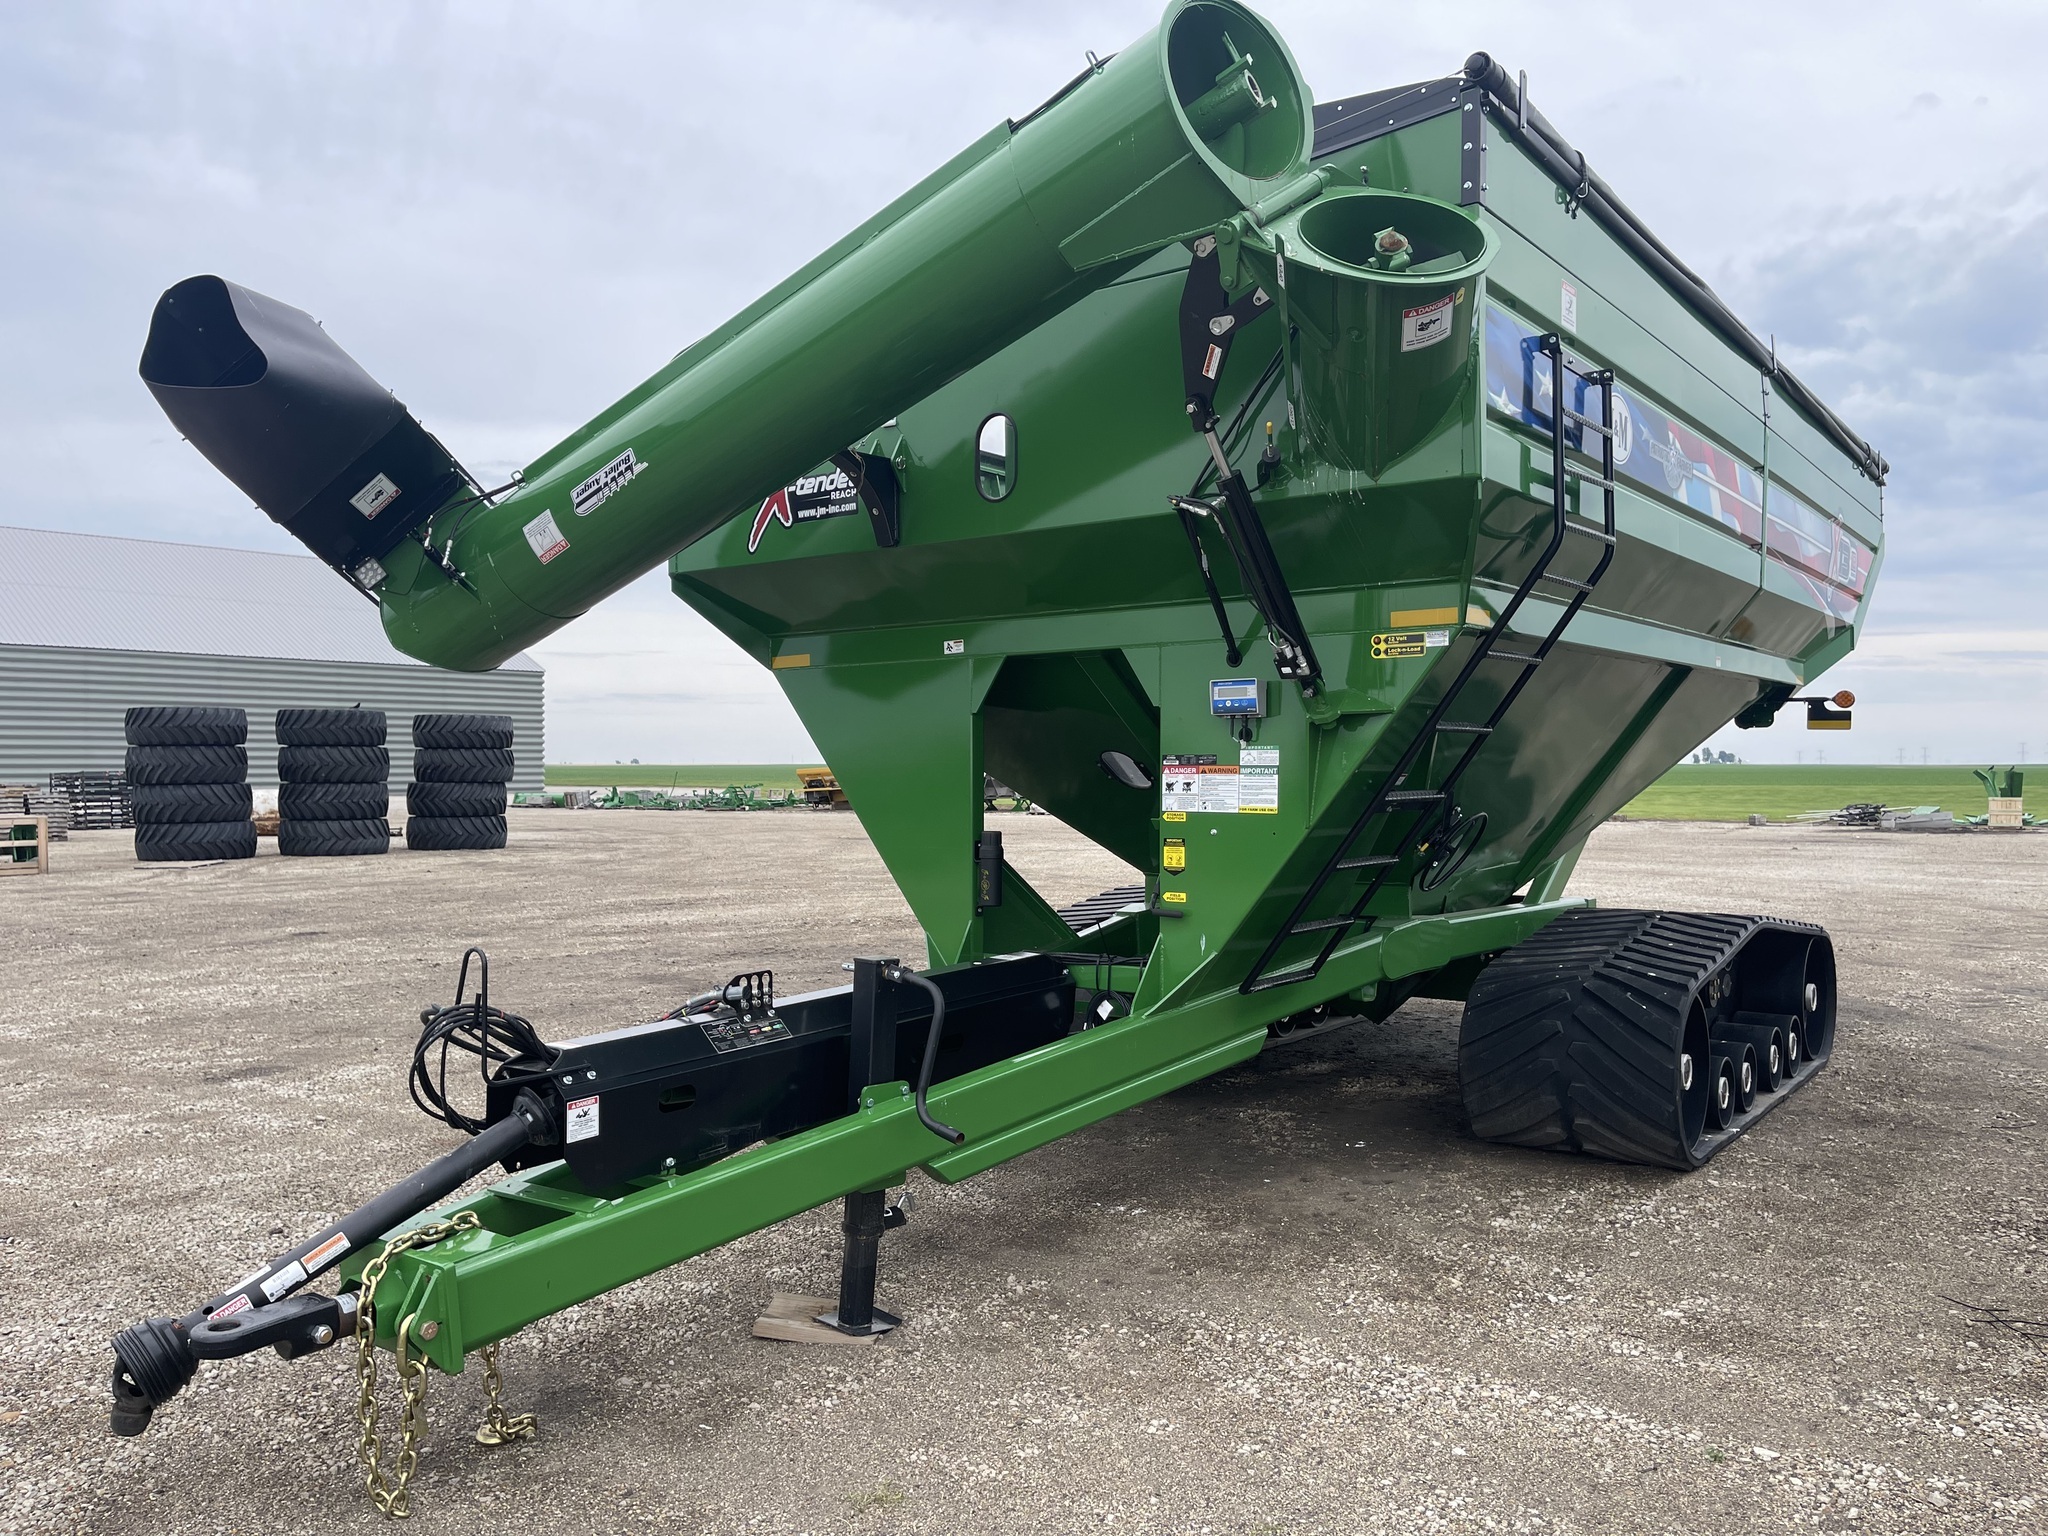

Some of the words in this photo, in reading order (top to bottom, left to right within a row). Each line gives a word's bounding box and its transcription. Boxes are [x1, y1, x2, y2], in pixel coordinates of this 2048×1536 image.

[1418, 298, 1450, 315] DANGER
[603, 454, 632, 479] Bullet
[575, 475, 602, 500] Auger
[831, 488, 857, 500] REACH
[370, 496, 392, 516] DANGER
[798, 502, 857, 518] www.jm-inc.com
[540, 543, 563, 563] DANGER
[576, 1098, 596, 1108] DANGER
[219, 1296, 248, 1319] DANGER
